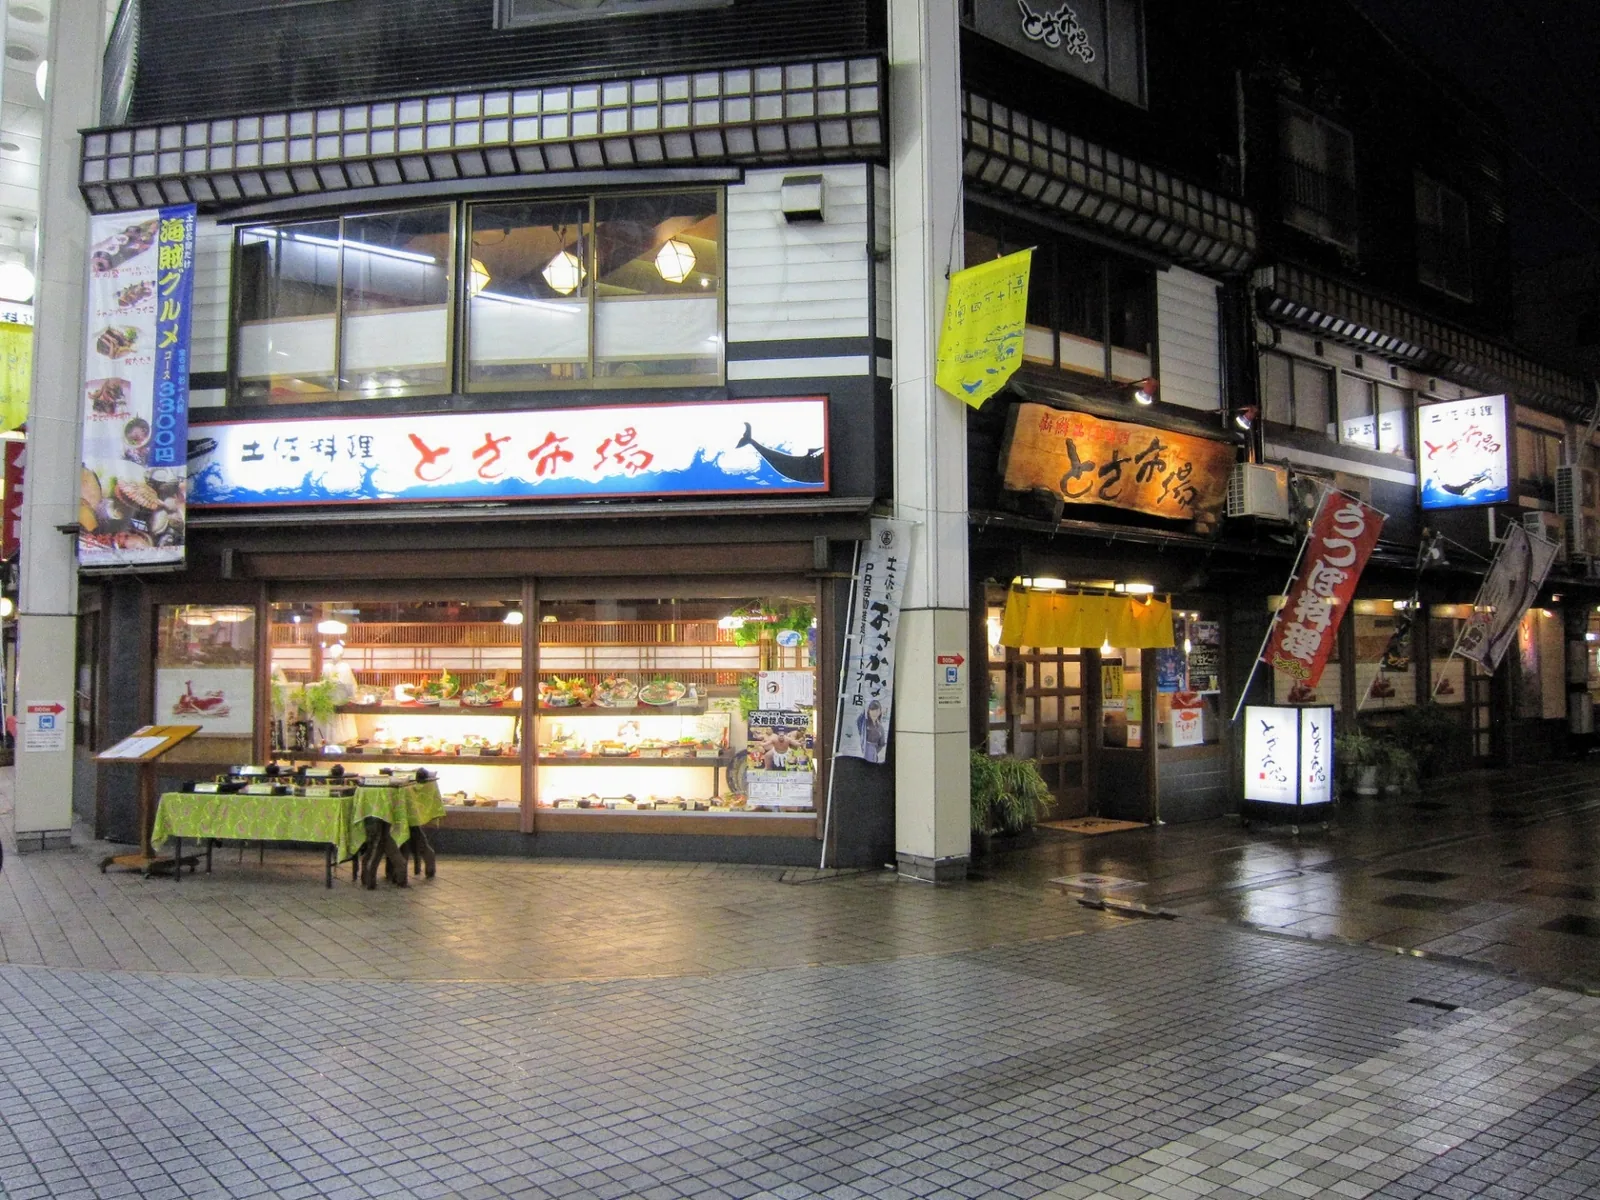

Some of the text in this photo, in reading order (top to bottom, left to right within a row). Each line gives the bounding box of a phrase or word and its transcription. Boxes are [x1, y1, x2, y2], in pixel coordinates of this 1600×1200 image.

[241, 426, 655, 482] 土佐料理 とさ市場
[1059, 436, 1198, 510] とさ市場
